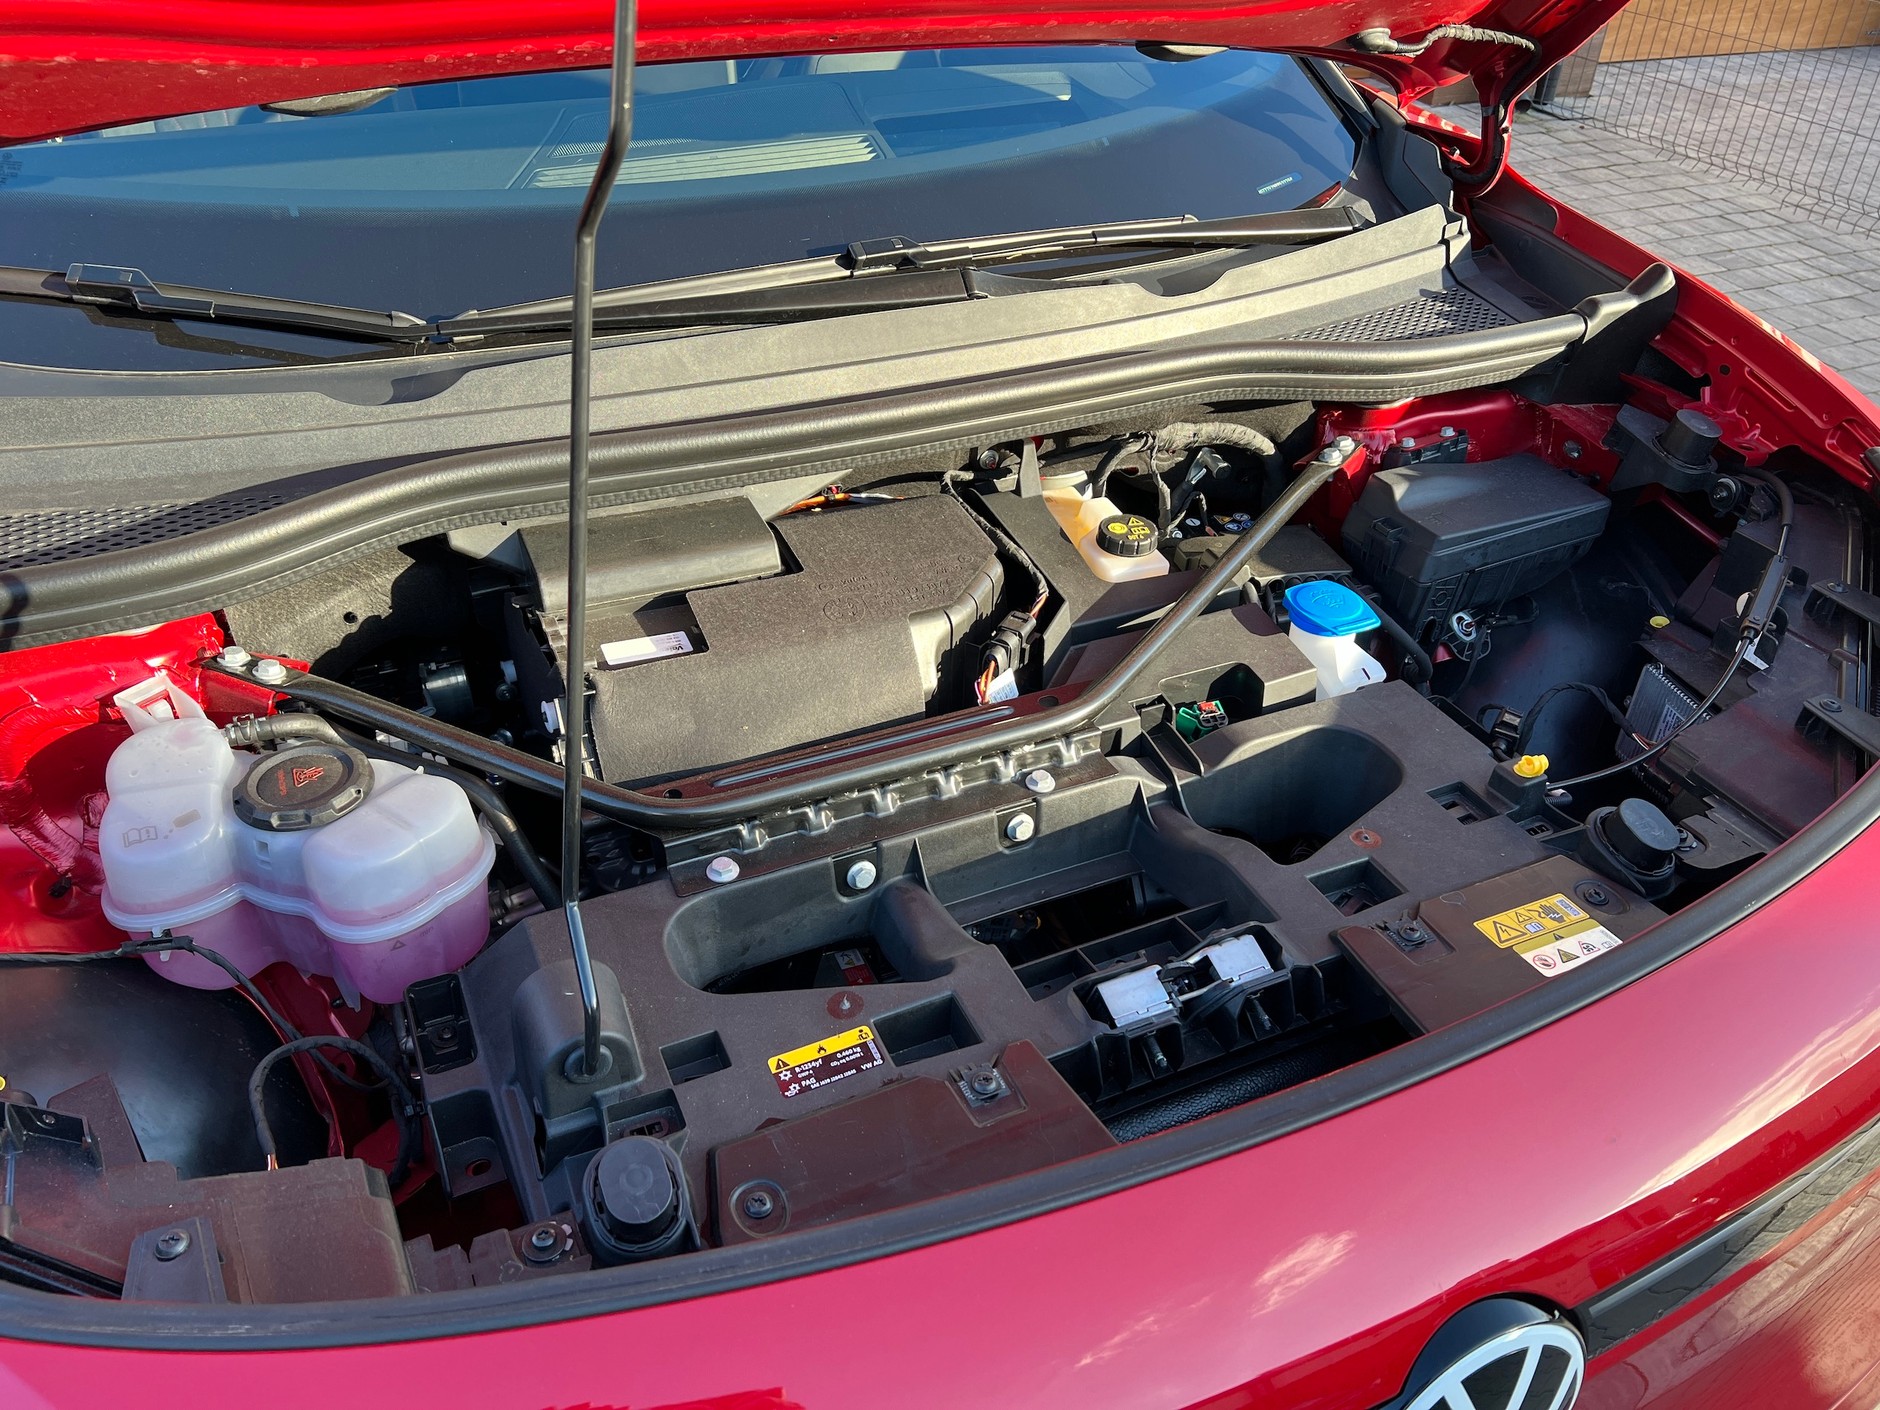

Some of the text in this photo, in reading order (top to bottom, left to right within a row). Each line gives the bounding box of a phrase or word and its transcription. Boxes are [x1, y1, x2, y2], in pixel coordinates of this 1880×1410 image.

[795, 1059, 822, 1072] R-1234yf
[861, 1062, 872, 1070] VW
[801, 1077, 816, 1087] PAG
